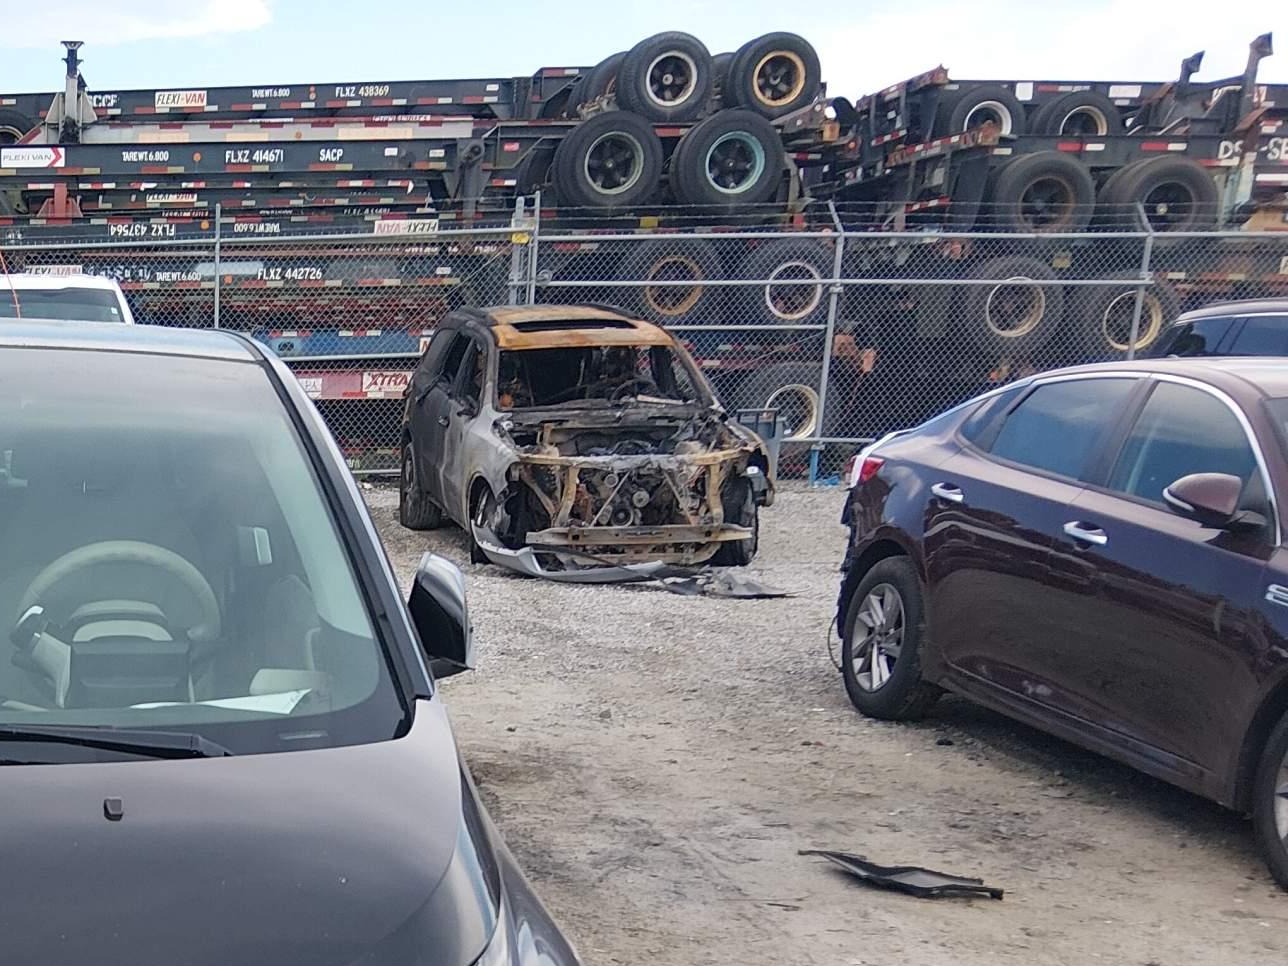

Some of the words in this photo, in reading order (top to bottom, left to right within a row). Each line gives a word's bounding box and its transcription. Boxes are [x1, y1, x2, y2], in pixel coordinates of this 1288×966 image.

[336, 87, 355, 97] FLXZ
[225, 150, 249, 163] FLXZ
[319, 149, 343, 161] SACP
[151, 224, 175, 237] FLXZ
[257, 268, 281, 280] FLXZ
